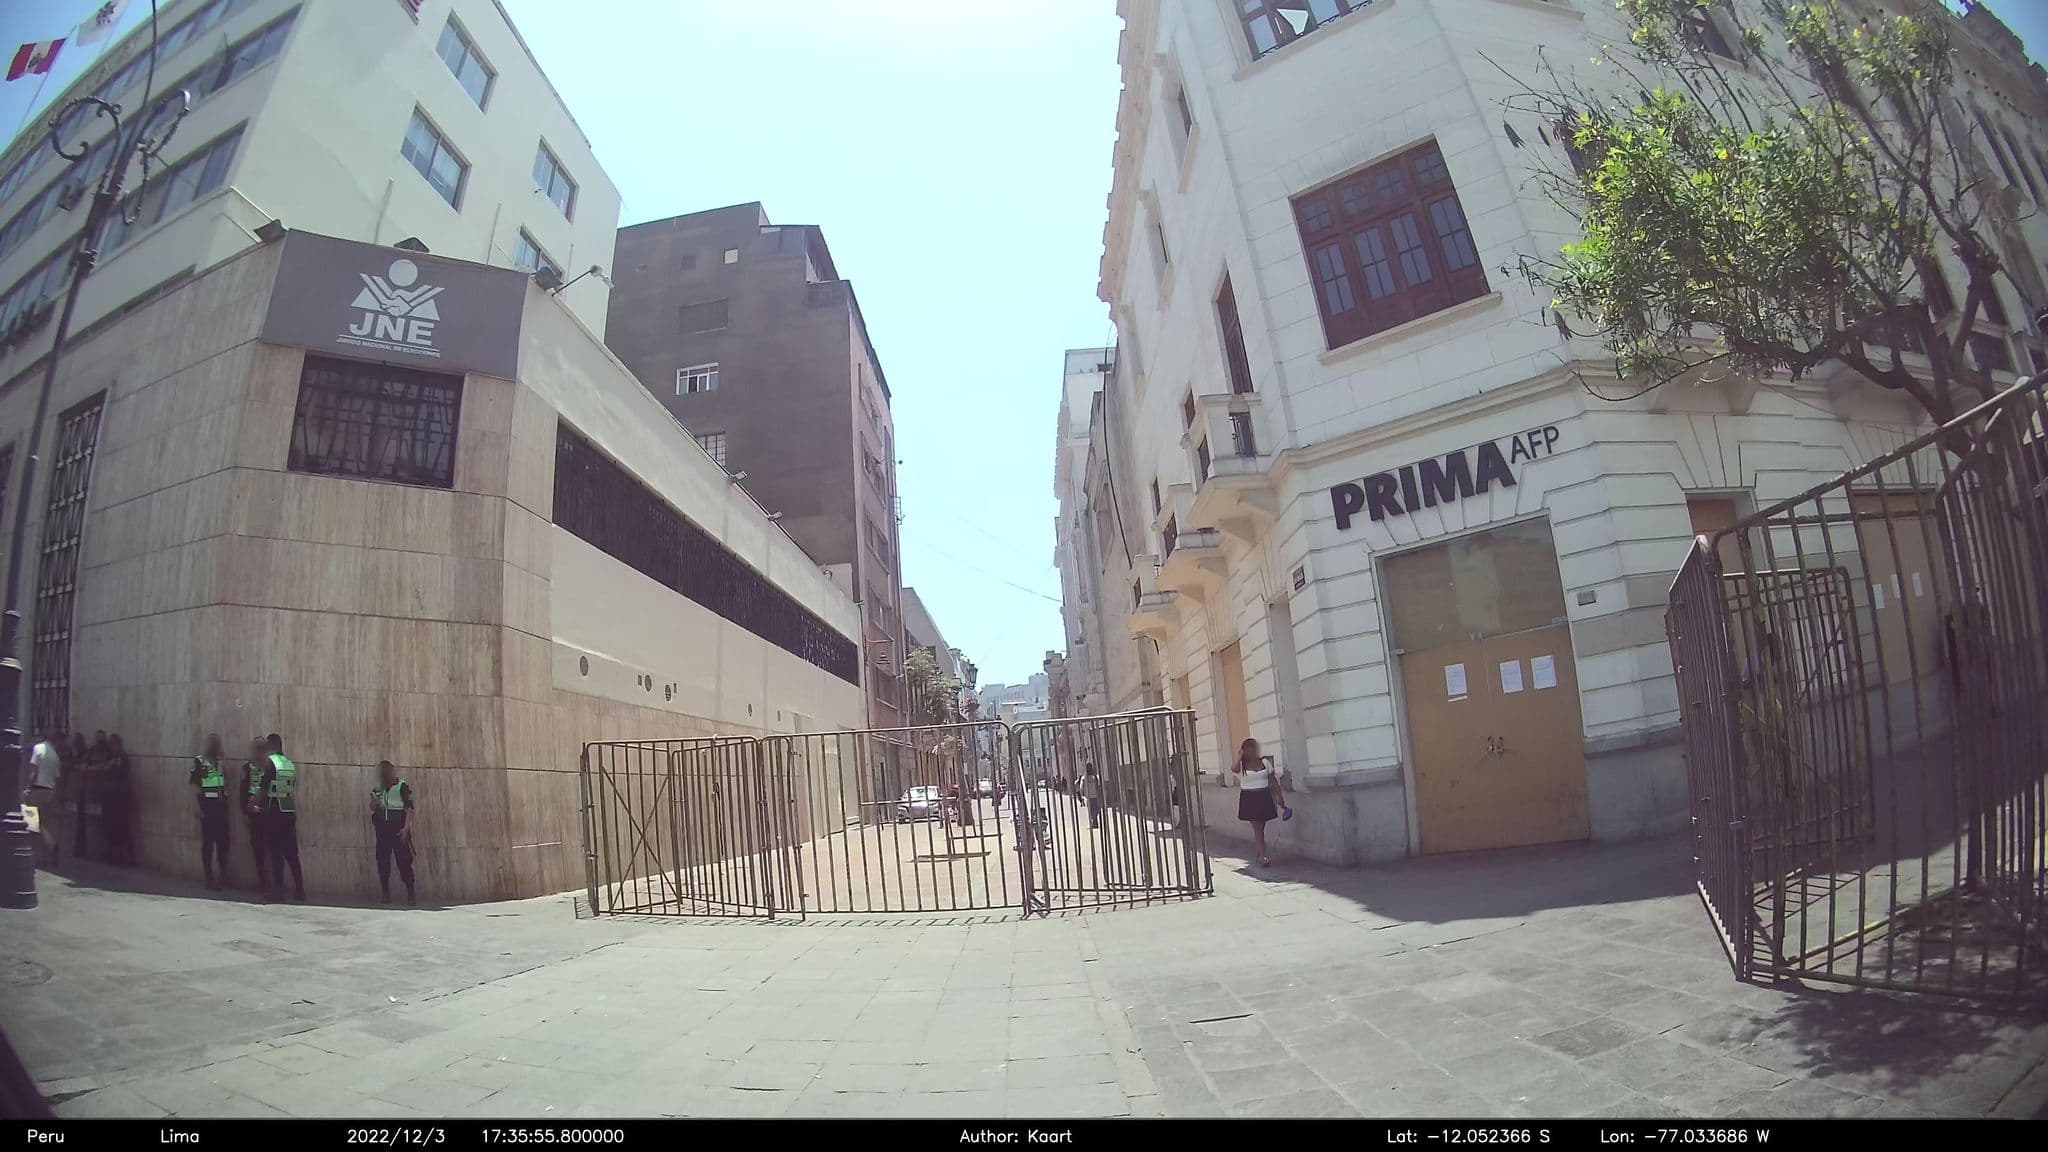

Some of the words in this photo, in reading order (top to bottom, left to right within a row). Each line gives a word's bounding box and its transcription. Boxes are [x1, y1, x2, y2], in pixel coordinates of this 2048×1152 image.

[349, 312, 435, 346] JNE
[1330, 441, 1518, 530] PRIMA
[1510, 425, 1560, 464] AFP
